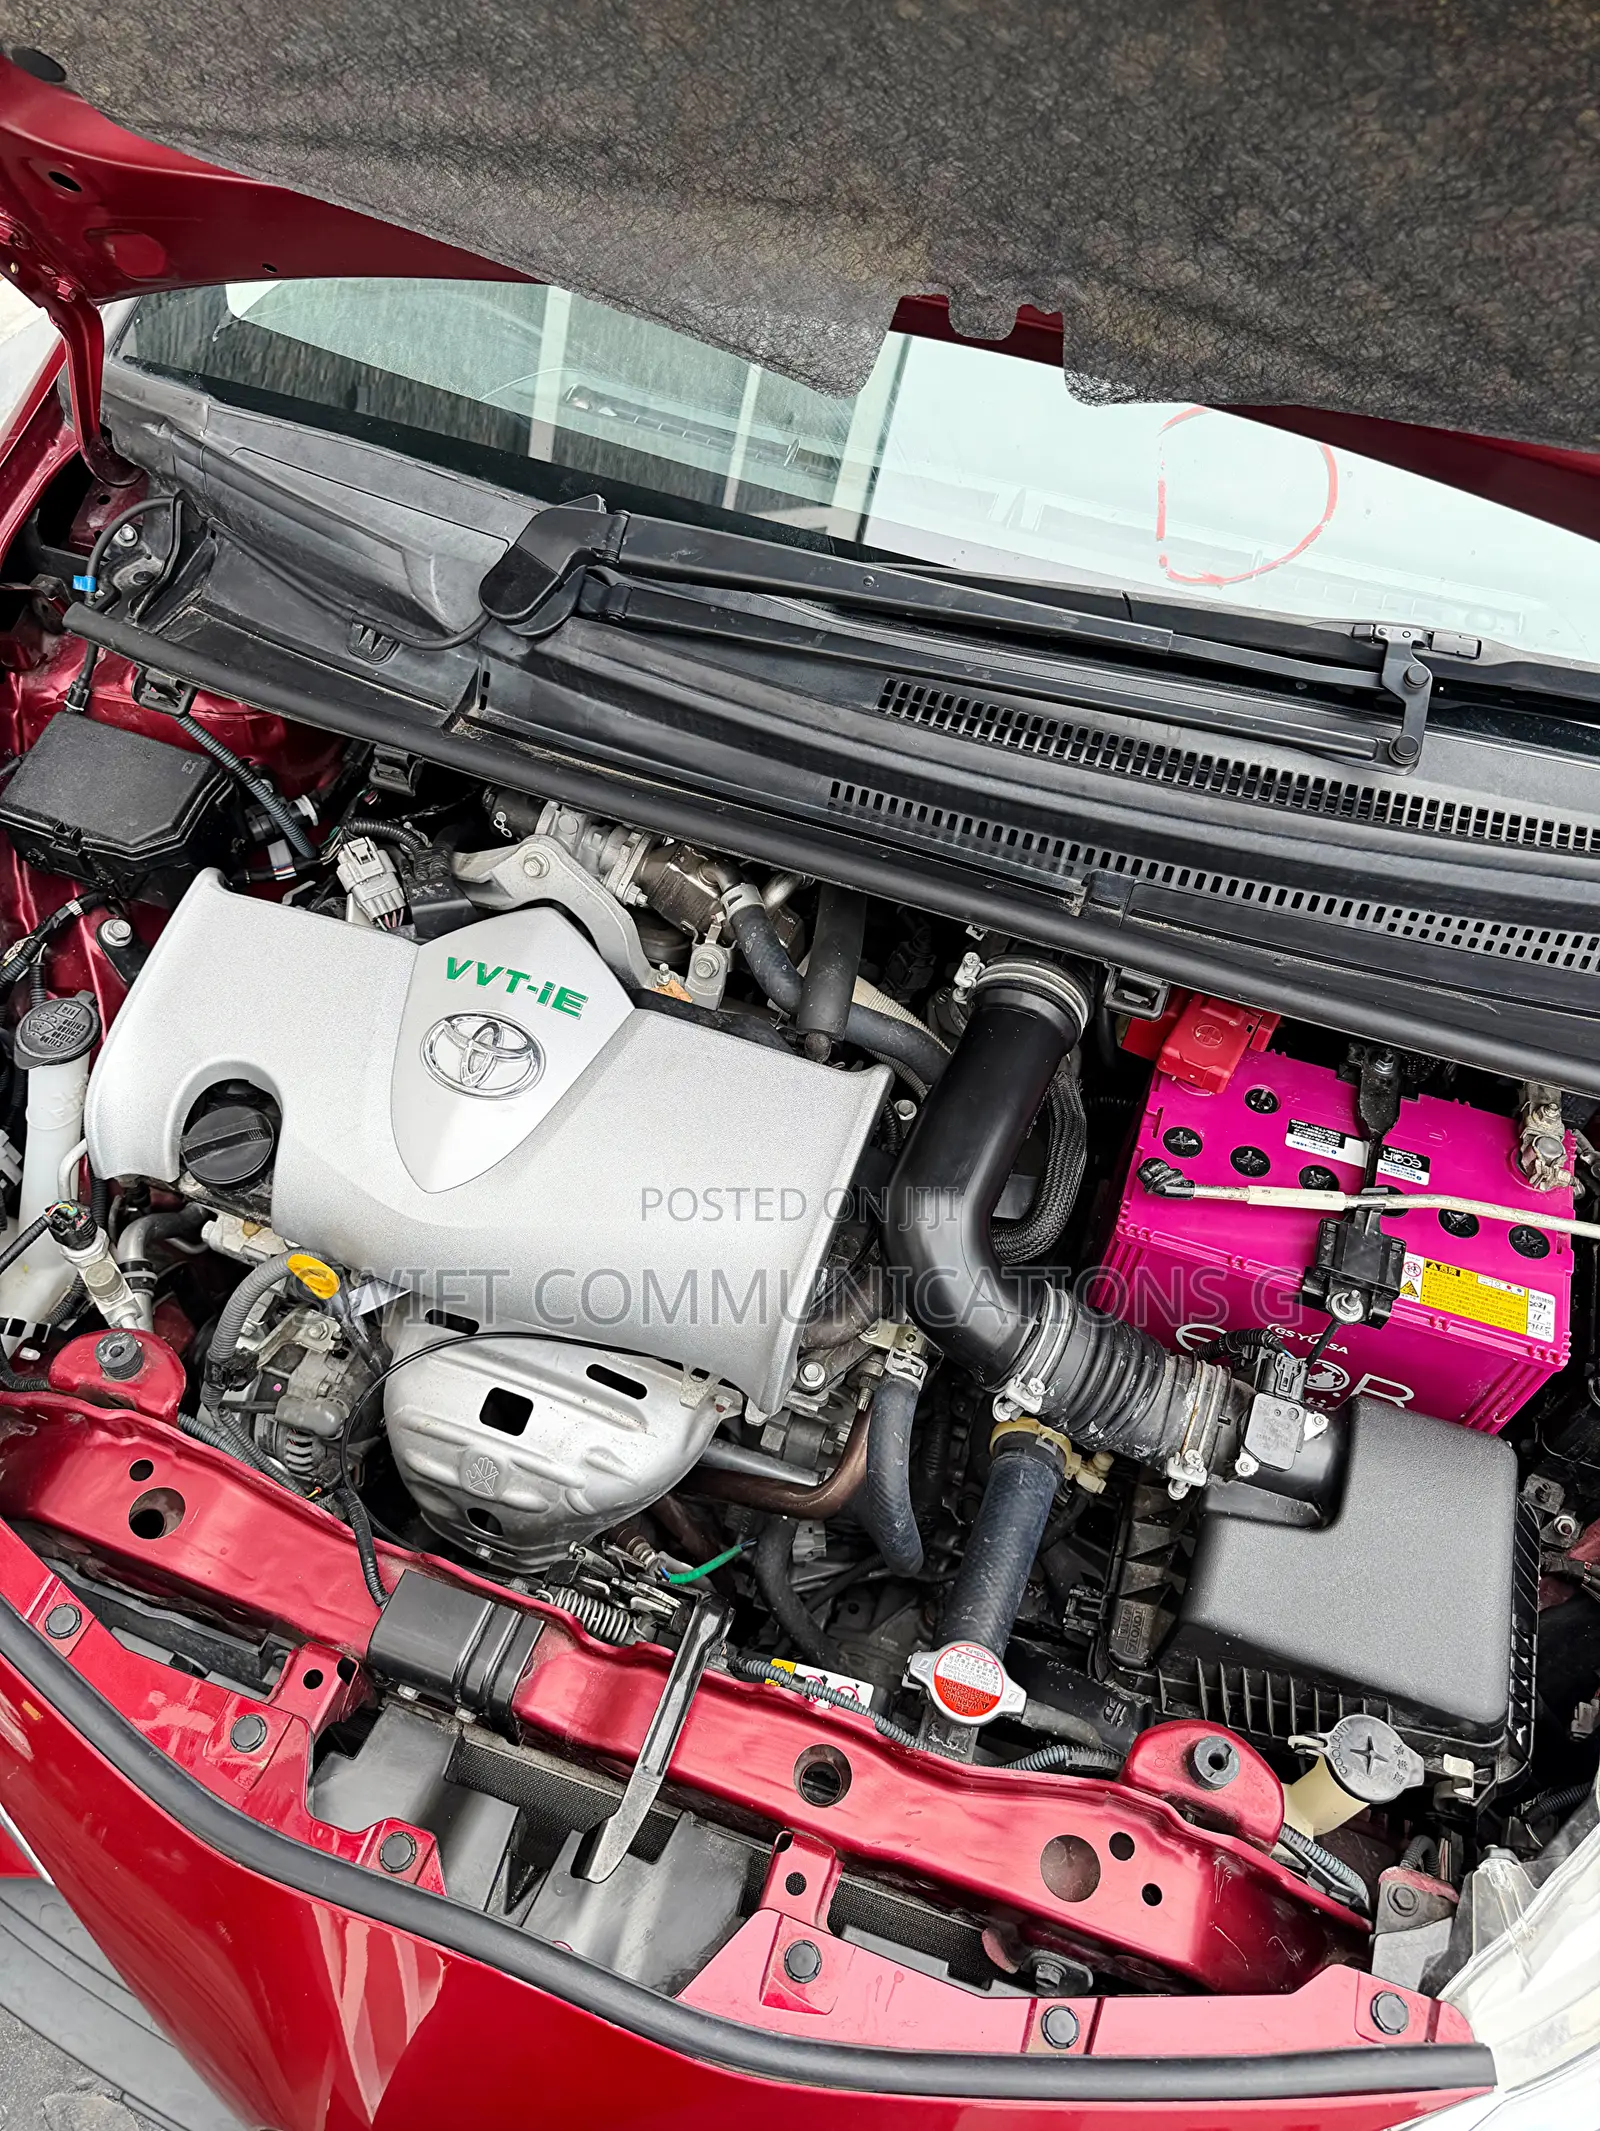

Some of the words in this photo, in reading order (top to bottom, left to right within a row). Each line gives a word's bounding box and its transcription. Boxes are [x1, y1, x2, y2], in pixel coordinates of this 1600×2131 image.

[446, 956, 588, 1020] VVT-iE
[1297, 1332, 1348, 1354] YUSA
[945, 1693, 978, 1710] WARNING
[1330, 1721, 1350, 1776] COOLANT
